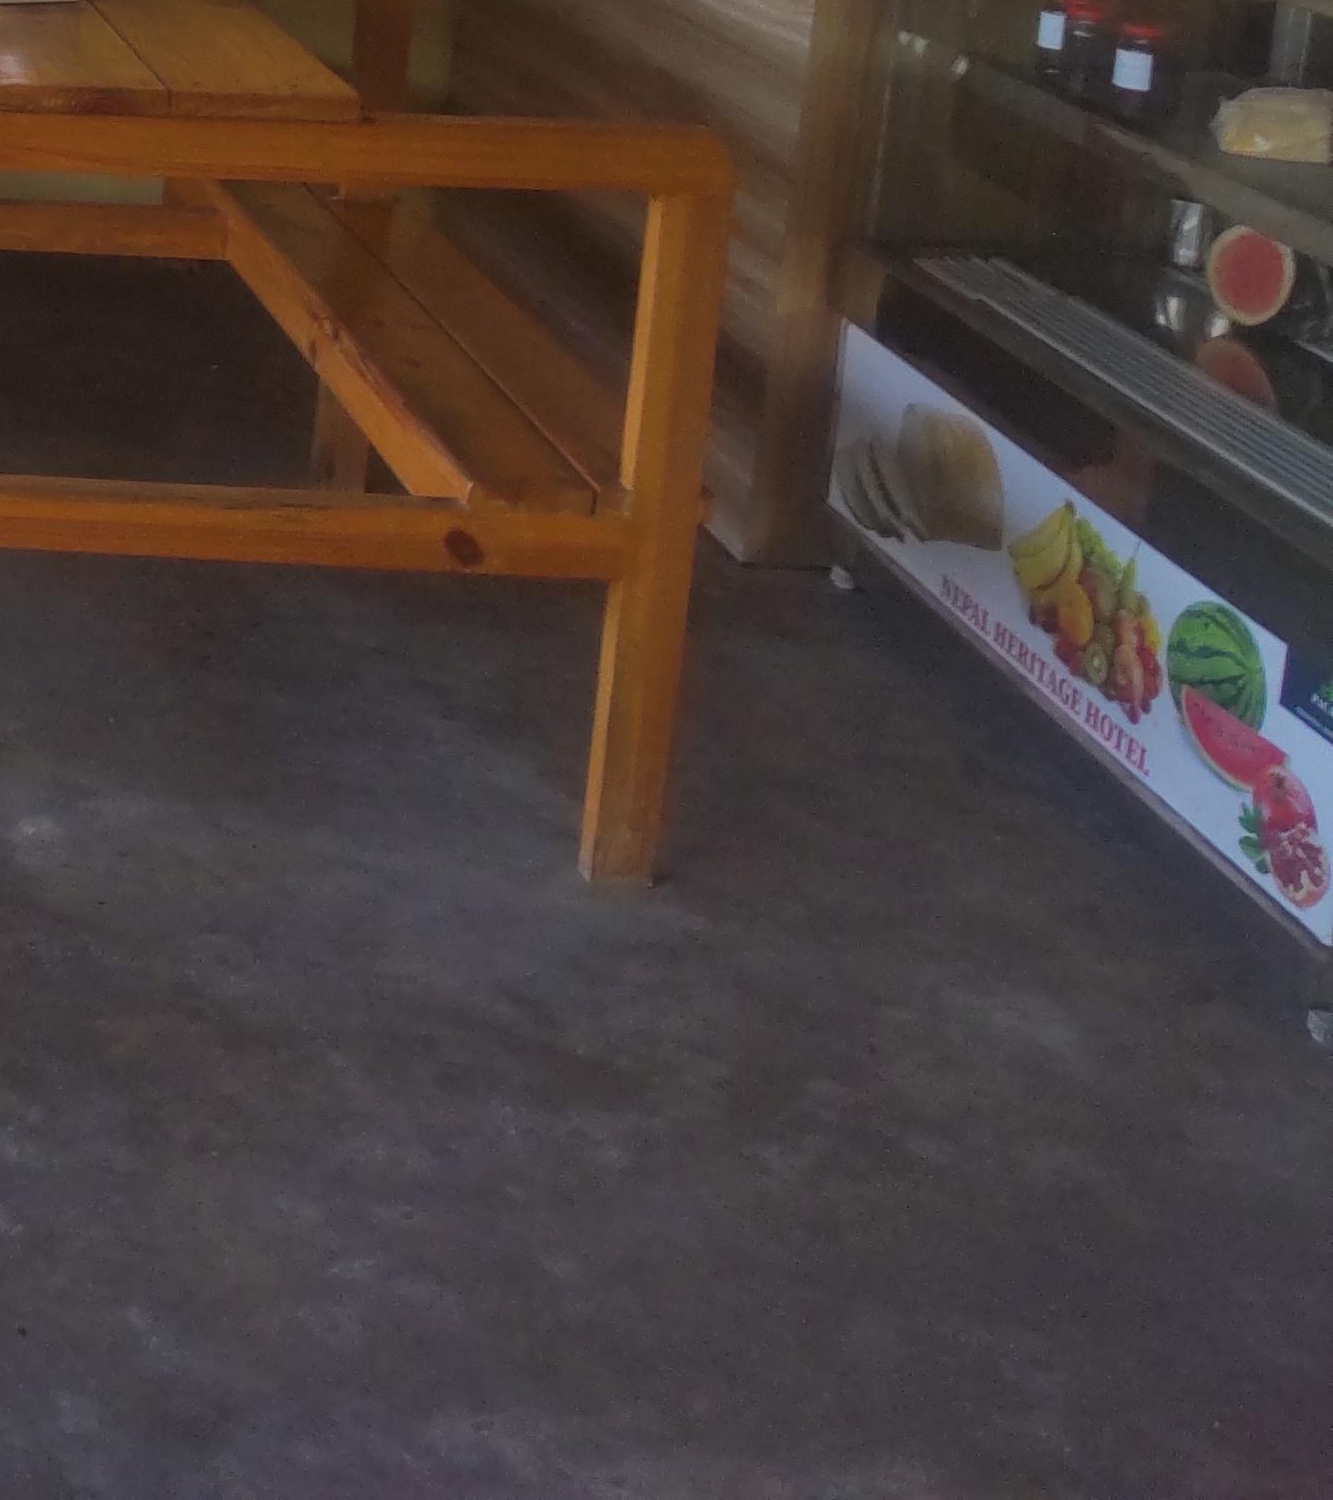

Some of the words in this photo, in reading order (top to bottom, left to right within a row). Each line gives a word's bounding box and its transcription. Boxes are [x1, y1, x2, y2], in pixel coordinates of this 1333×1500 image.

[940, 573, 992, 637] NEPAL
[993, 621, 1081, 716] HERITAGE
[1084, 701, 1151, 778] HOTEL
